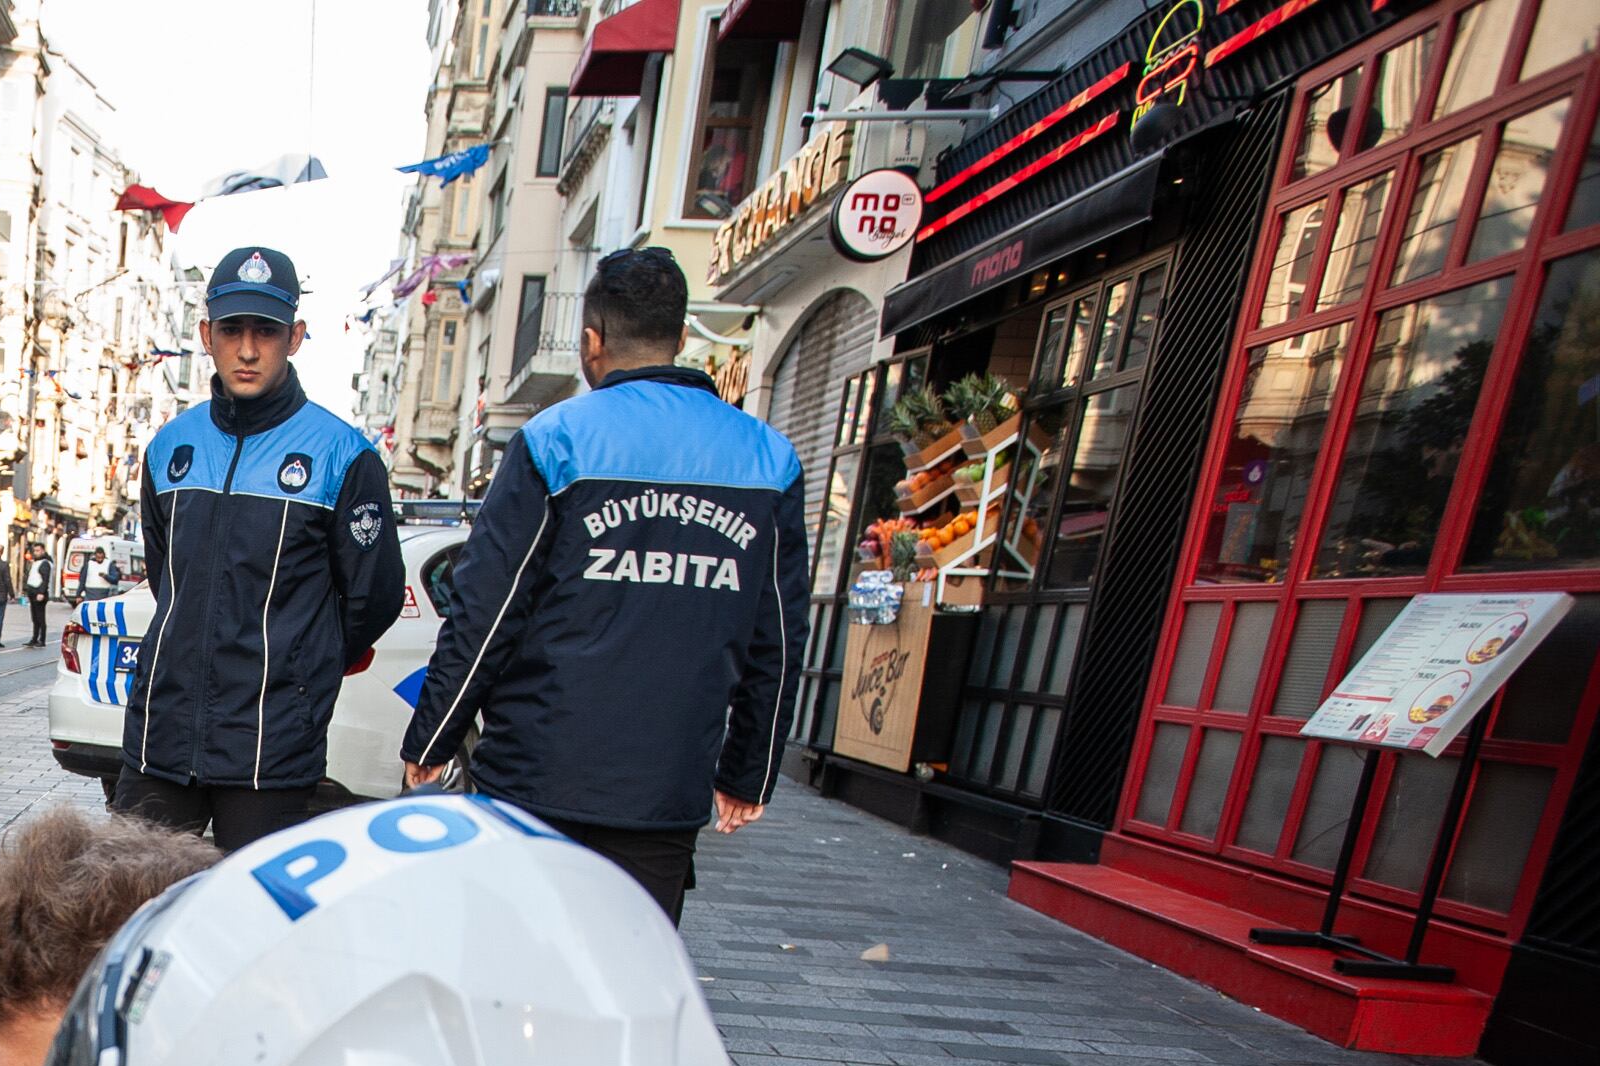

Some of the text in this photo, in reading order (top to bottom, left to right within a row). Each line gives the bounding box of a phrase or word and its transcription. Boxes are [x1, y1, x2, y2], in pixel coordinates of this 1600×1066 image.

[971, 240, 1024, 288] mono
[583, 489, 757, 551] BÜYÜKŞEHİR
[583, 548, 740, 592] ZABITA
[885, 648, 911, 683] Bar
